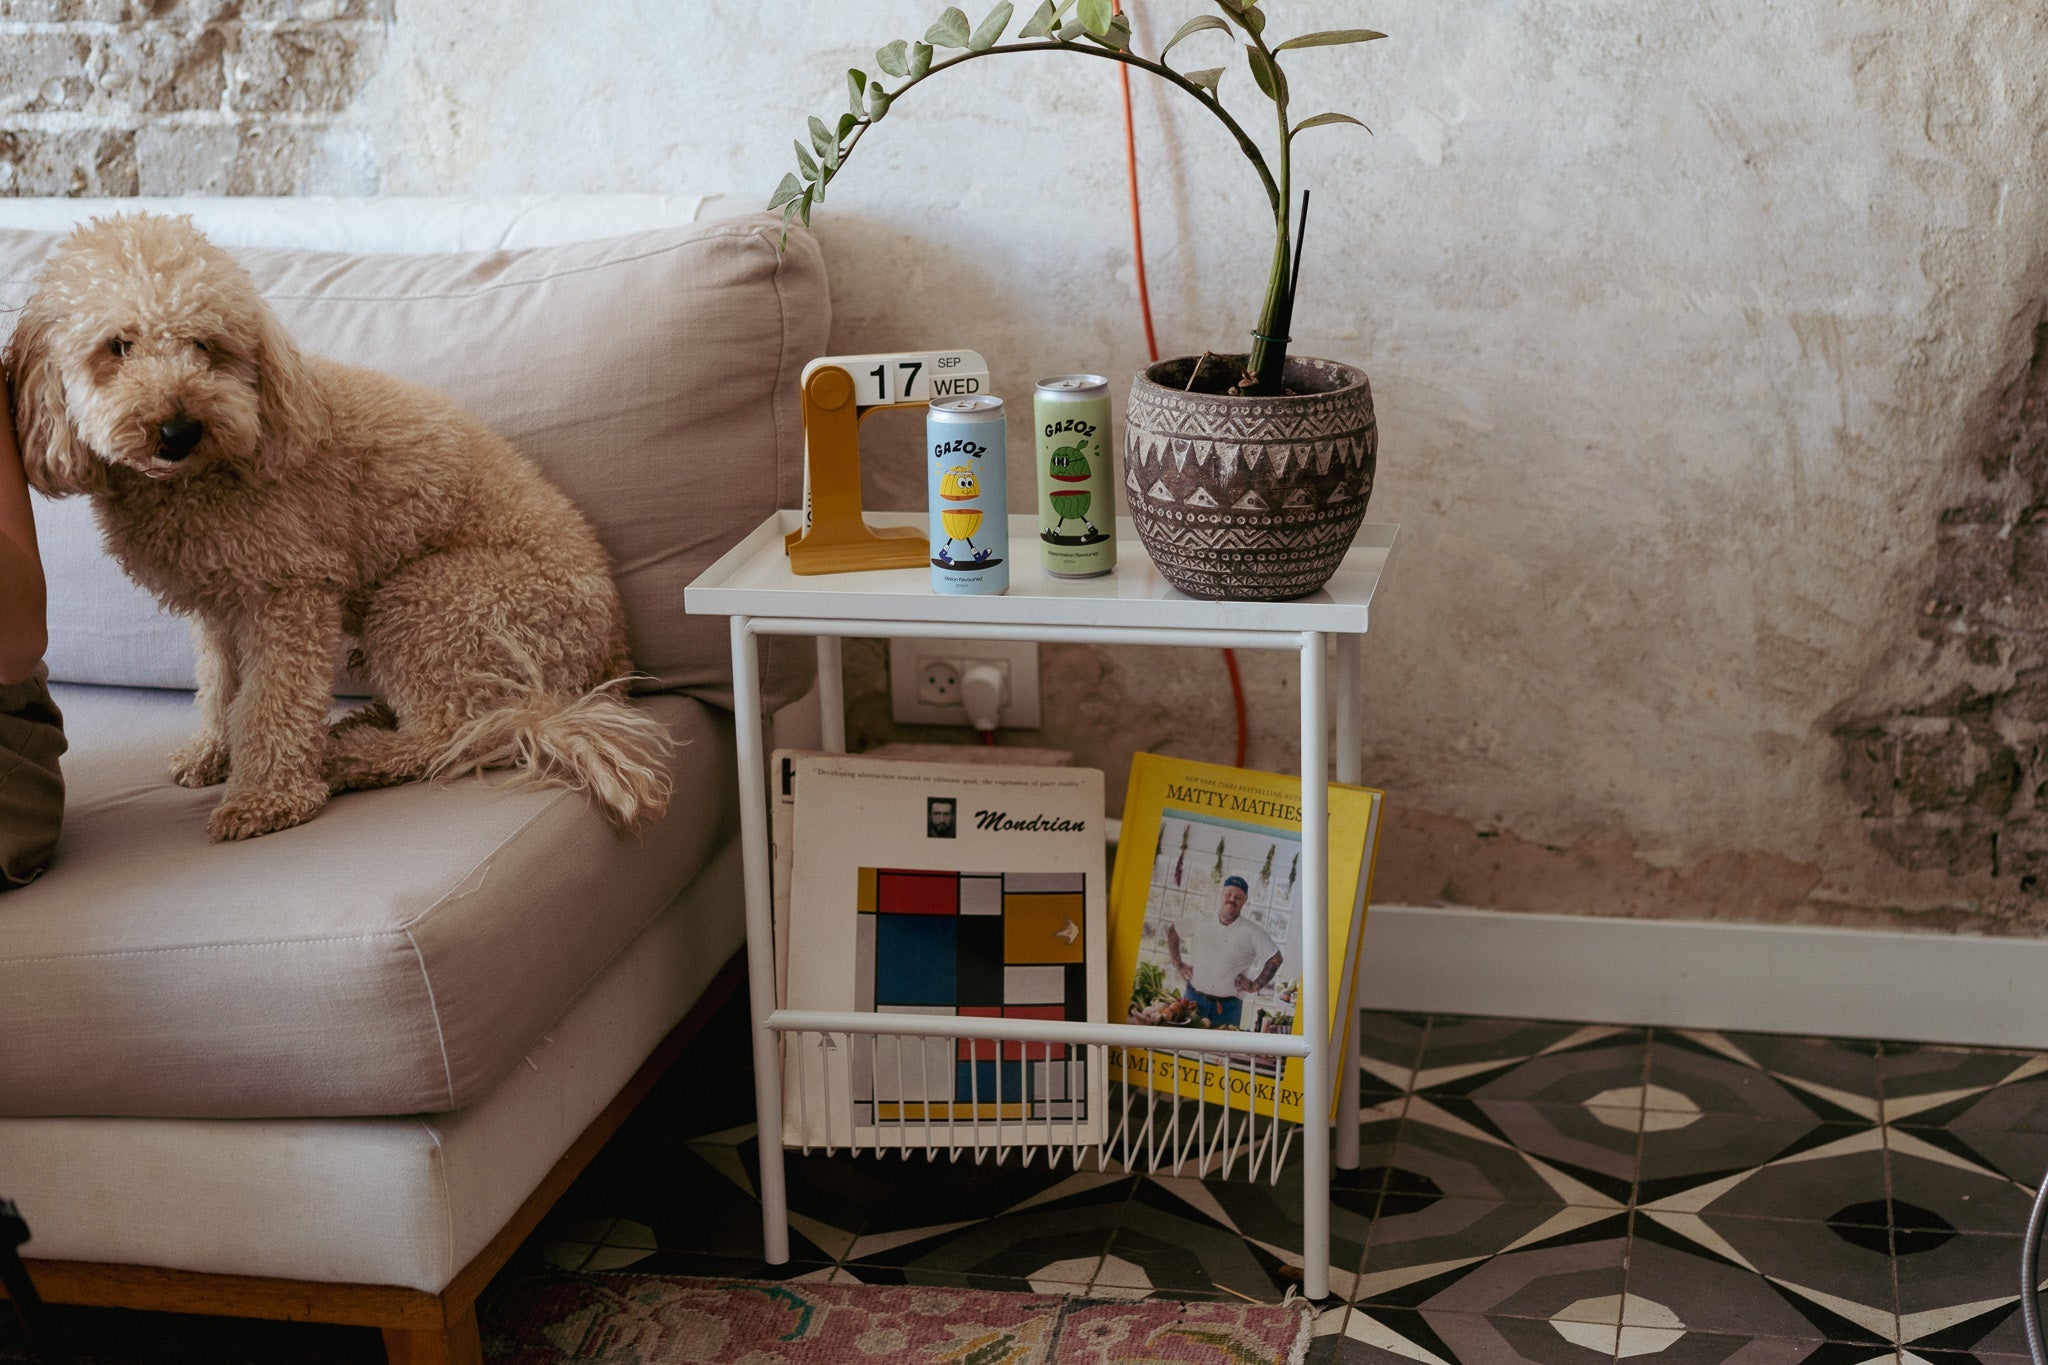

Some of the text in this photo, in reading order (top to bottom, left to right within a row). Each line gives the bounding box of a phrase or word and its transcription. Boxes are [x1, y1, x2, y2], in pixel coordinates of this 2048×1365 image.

[938, 357, 961, 369] SEP
[870, 362, 979, 399] 17 WED
[1045, 419, 1097, 438] GAZOZ
[934, 439, 987, 458] GAZOZ
[1166, 784, 1331, 823] MATTY MATHES
[974, 810, 1086, 832] Mondrian
[1159, 1062, 1215, 1088] STYLE
[1218, 1075, 1304, 1107] COOKERY
